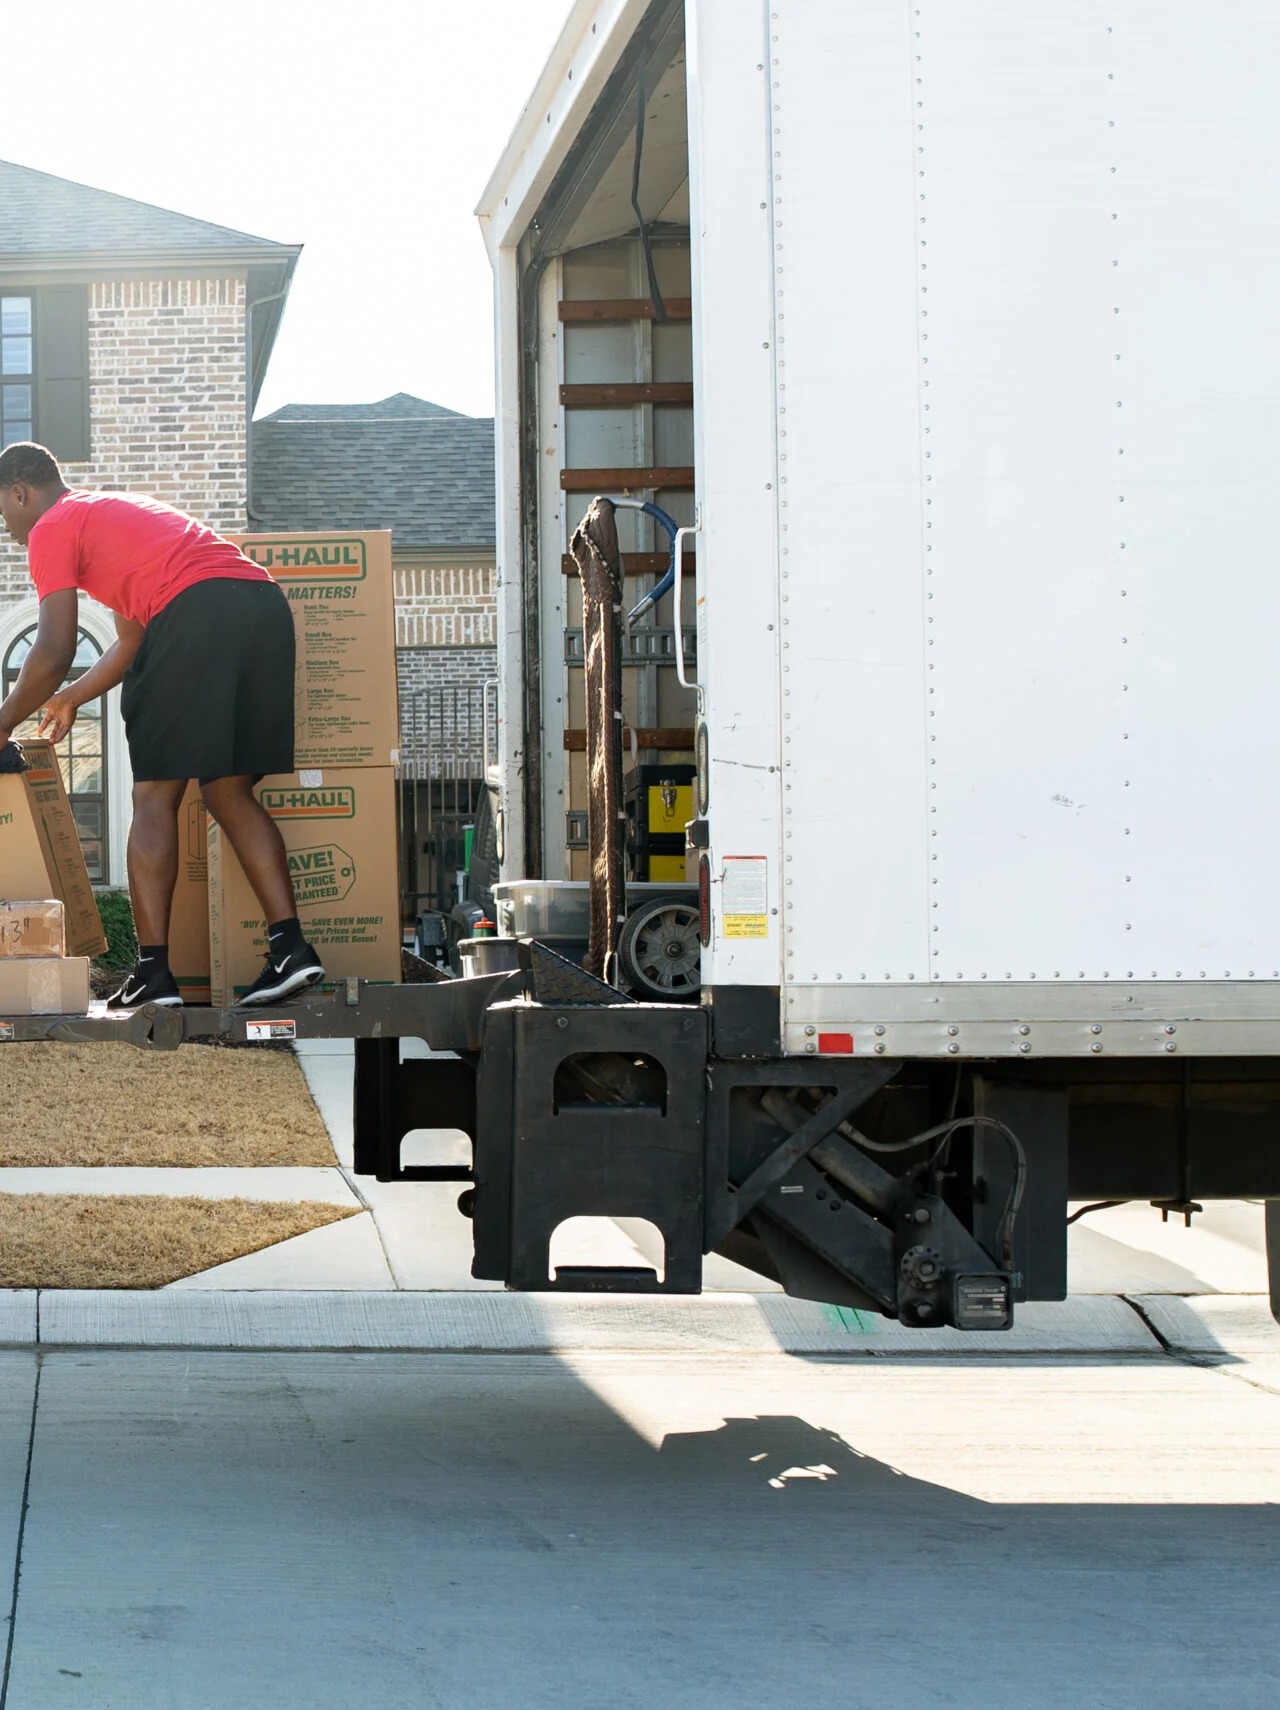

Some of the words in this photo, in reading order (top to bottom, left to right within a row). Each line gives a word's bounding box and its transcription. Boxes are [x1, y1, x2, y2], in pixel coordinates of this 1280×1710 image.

[250, 546, 358, 567] U-HAUL
[287, 586, 357, 600] MATTERS!
[267, 792, 349, 808] U-HAUL
[288, 850, 334, 872] AVE!
[304, 874, 336, 888] PRICE
[295, 887, 339, 901] RANTEED
[334, 917, 354, 925] EVEN
[356, 916, 383, 925] MORE!
